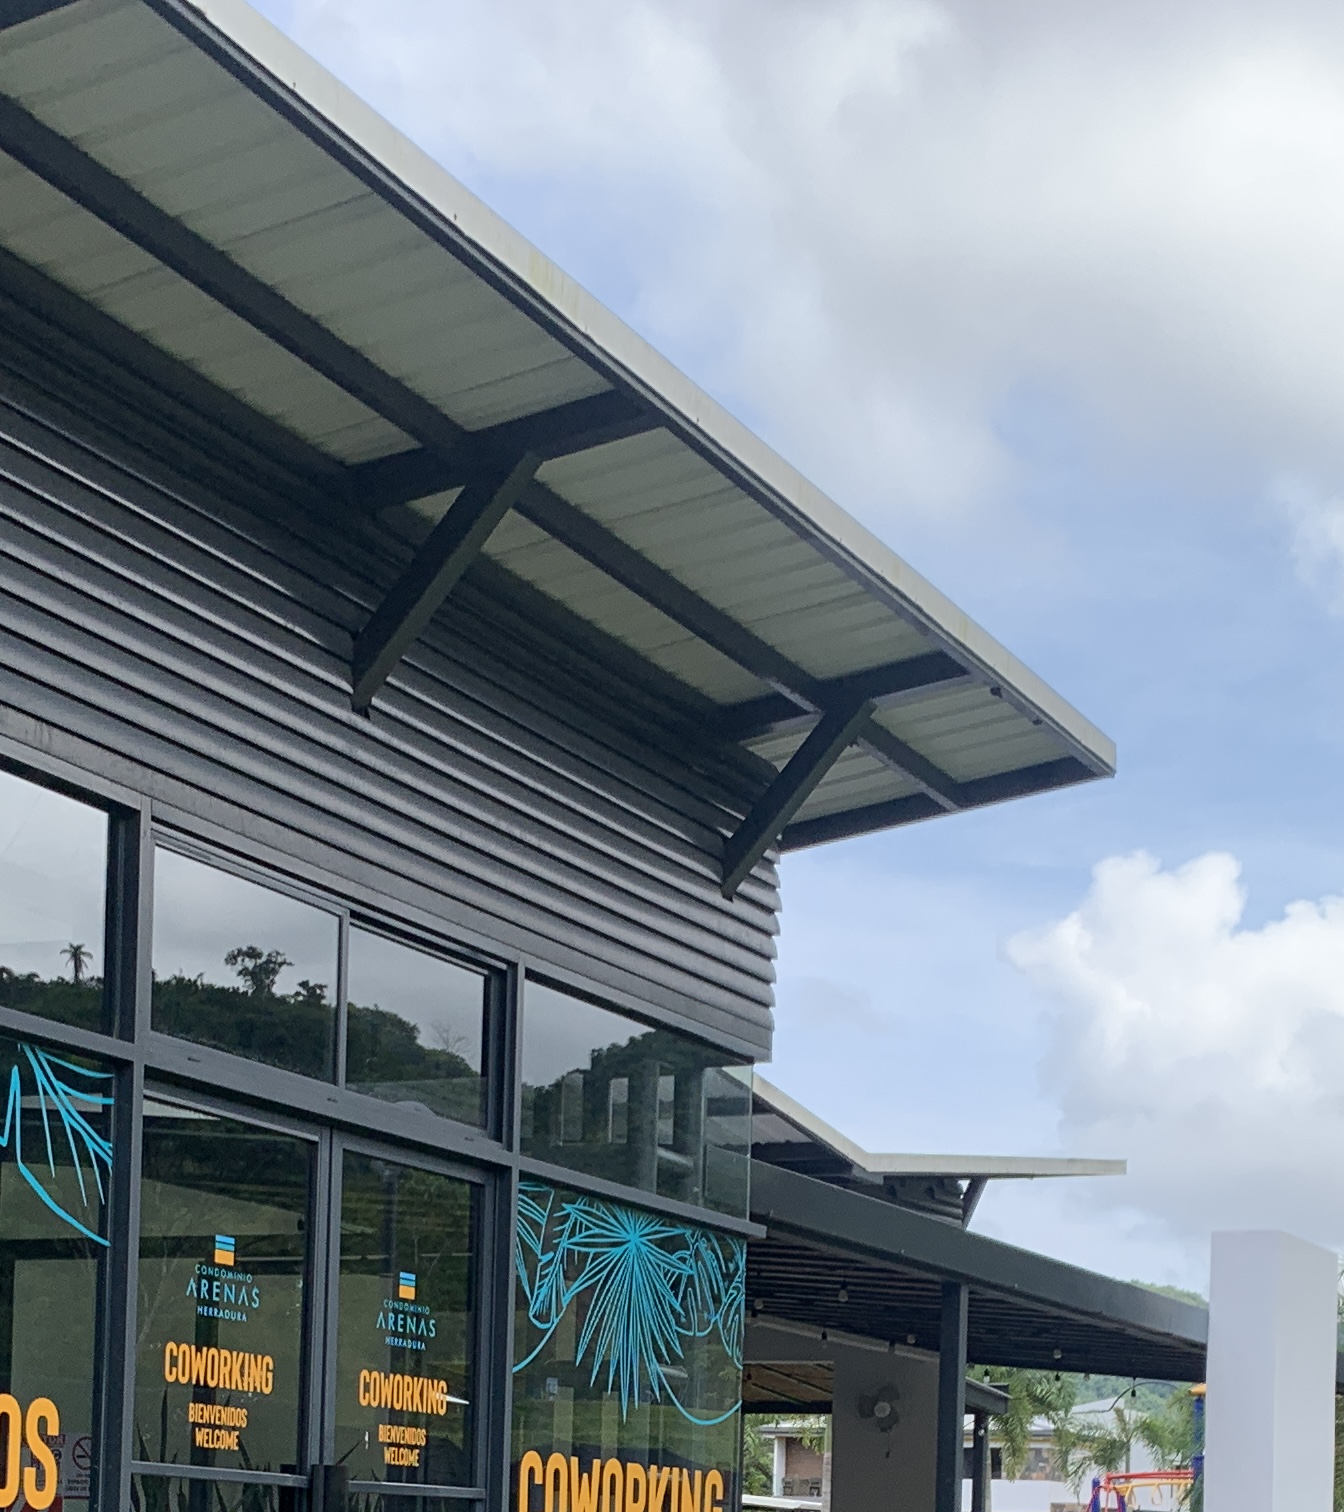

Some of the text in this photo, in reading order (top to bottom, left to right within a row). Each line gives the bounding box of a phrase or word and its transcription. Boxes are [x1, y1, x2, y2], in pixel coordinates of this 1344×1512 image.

[195, 1264, 253, 1283] CONDOMINIO
[186, 1277, 260, 1309] ARENAS
[197, 1305, 247, 1322] HERRADURA
[383, 1299, 430, 1316] CONDOMINIO
[376, 1311, 436, 1338] ARENAS
[385, 1336, 426, 1351] HERRADURA
[164, 1341, 274, 1395] COWORKING
[359, 1369, 448, 1416] COWORKING
[188, 1402, 248, 1428] BIENVENIDOS
[195, 1427, 240, 1450] WELCOME
[378, 1424, 427, 1447] BIENVENIDOS
[383, 1446, 420, 1467] WELCOME
